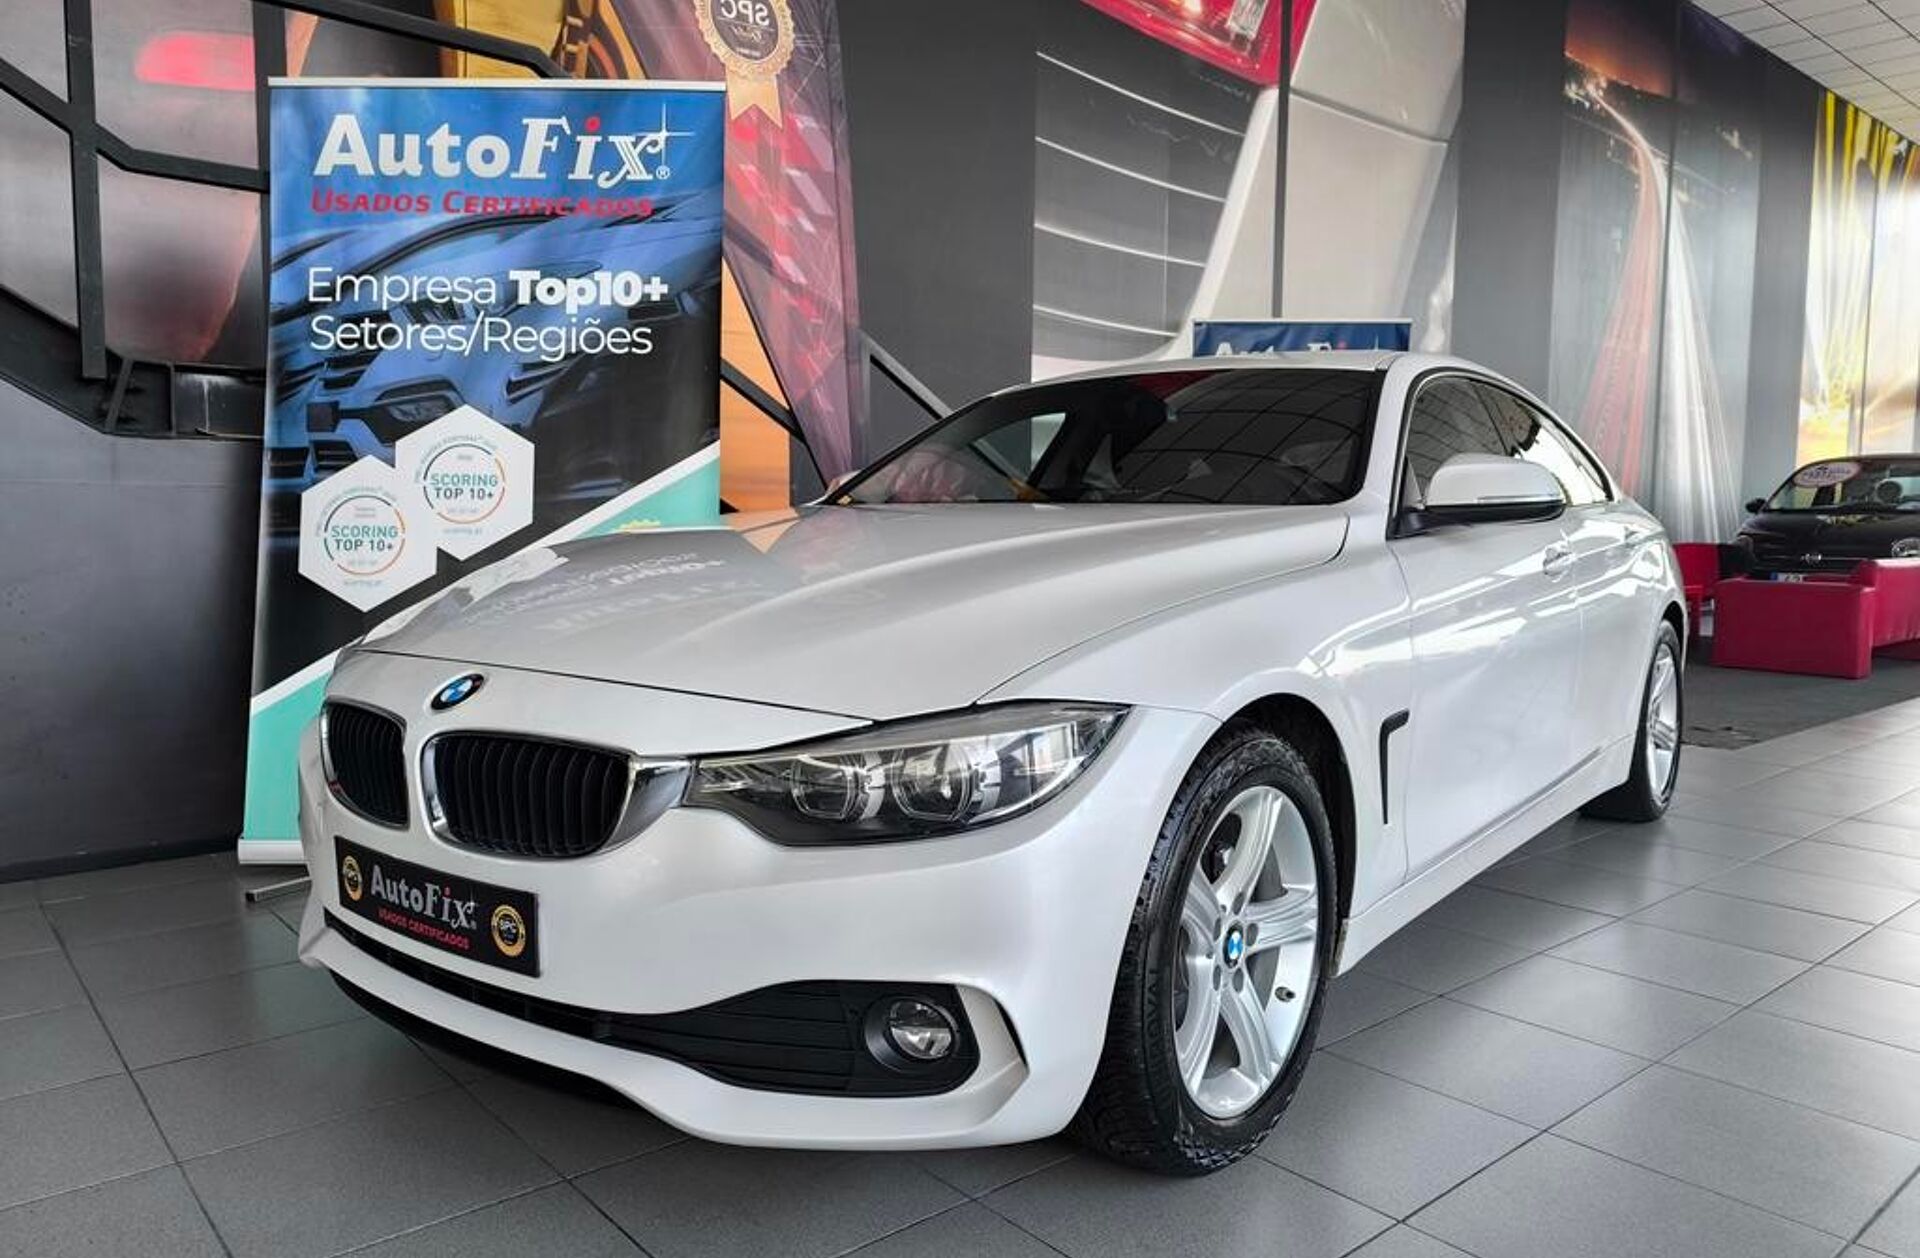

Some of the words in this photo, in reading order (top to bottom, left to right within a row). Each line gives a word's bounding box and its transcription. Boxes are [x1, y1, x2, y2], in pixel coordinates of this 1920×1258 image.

[308, 267, 496, 310] Empresa
[508, 269, 668, 315] Top10+
[310, 311, 653, 362] Setores/Regiões
[430, 473, 498, 487] SCORING
[434, 487, 464, 500] TOP
[469, 487, 494, 500] 10+
[331, 525, 398, 538] SCORING
[335, 538, 363, 551] TOP
[368, 538, 393, 551] 10+
